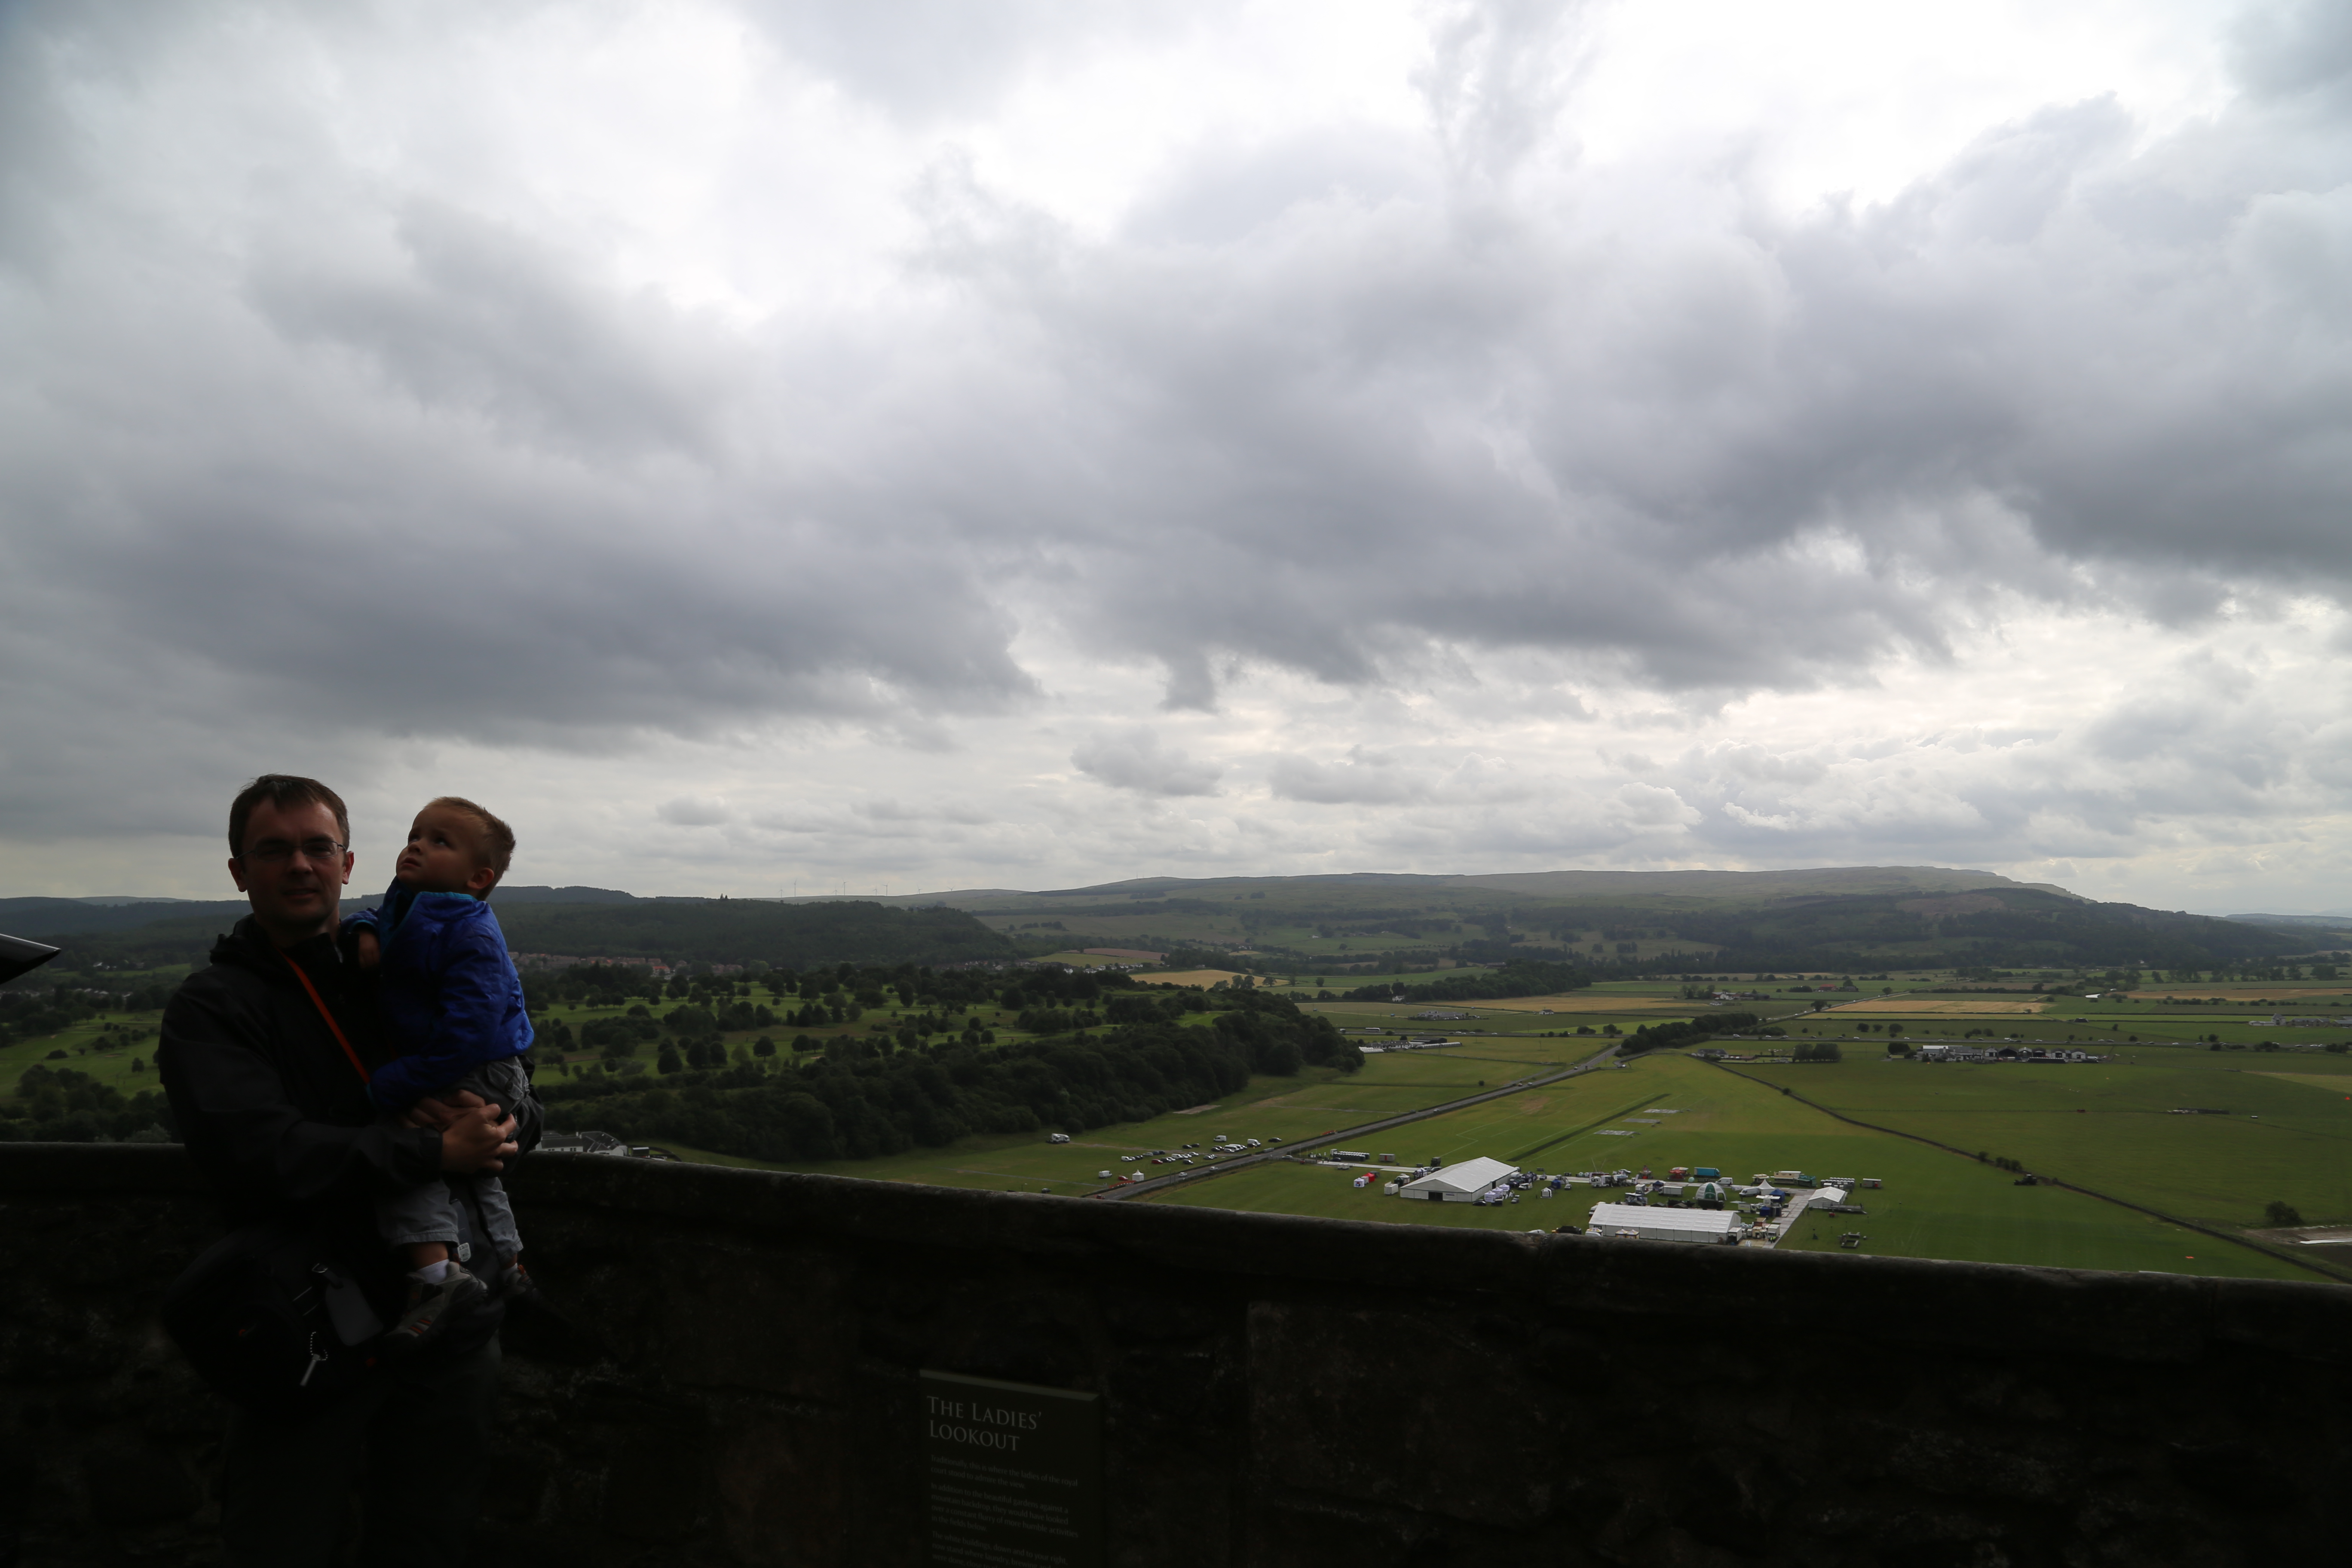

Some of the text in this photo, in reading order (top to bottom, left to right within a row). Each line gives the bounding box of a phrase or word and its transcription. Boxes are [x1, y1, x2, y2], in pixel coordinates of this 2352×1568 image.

[927, 1396, 1041, 1430] THE LADIES'
[930, 1420, 1020, 1451] LOOKOUT
[931, 1455, 968, 1469] Traditionally,
[970, 1461, 980, 1470] this
[988, 1465, 1008, 1475] where
[1021, 1470, 1039, 1480] ladies
[1049, 1475, 1060, 1483] the
[1061, 1479, 1078, 1487] royal
[974, 1474, 996, 1483] admire
[998, 1478, 1008, 1486] the
[931, 1494, 1068, 1525] mountain backdrop, they would have looked
[938, 1484, 963, 1494] addition
[984, 1492, 1011, 1504] beautiful
[1013, 1499, 1038, 1508] gardens
[1040, 1504, 1063, 1513] against
[939, 1516, 948, 1524] the
[949, 1517, 966, 1527] fields
[968, 1521, 987, 1531] below.
[951, 1509, 977, 1519] constant
[978, 1513, 995, 1524] flurry
[1023, 1521, 1047, 1532] humble
[1049, 1528, 1078, 1538] activities
[932, 1531, 943, 1539] The
[944, 1534, 961, 1543] white
[962, 1537, 992, 1550] buildings,
[993, 1544, 1011, 1553] down
[1050, 1556, 1068, 1565] right,
[946, 1546, 963, 1554] stand
[965, 1549, 983, 1558] where
[985, 1553, 1010, 1565] laundry,
[948, 1556, 965, 1566] done,
[967, 1560, 982, 1568] close
